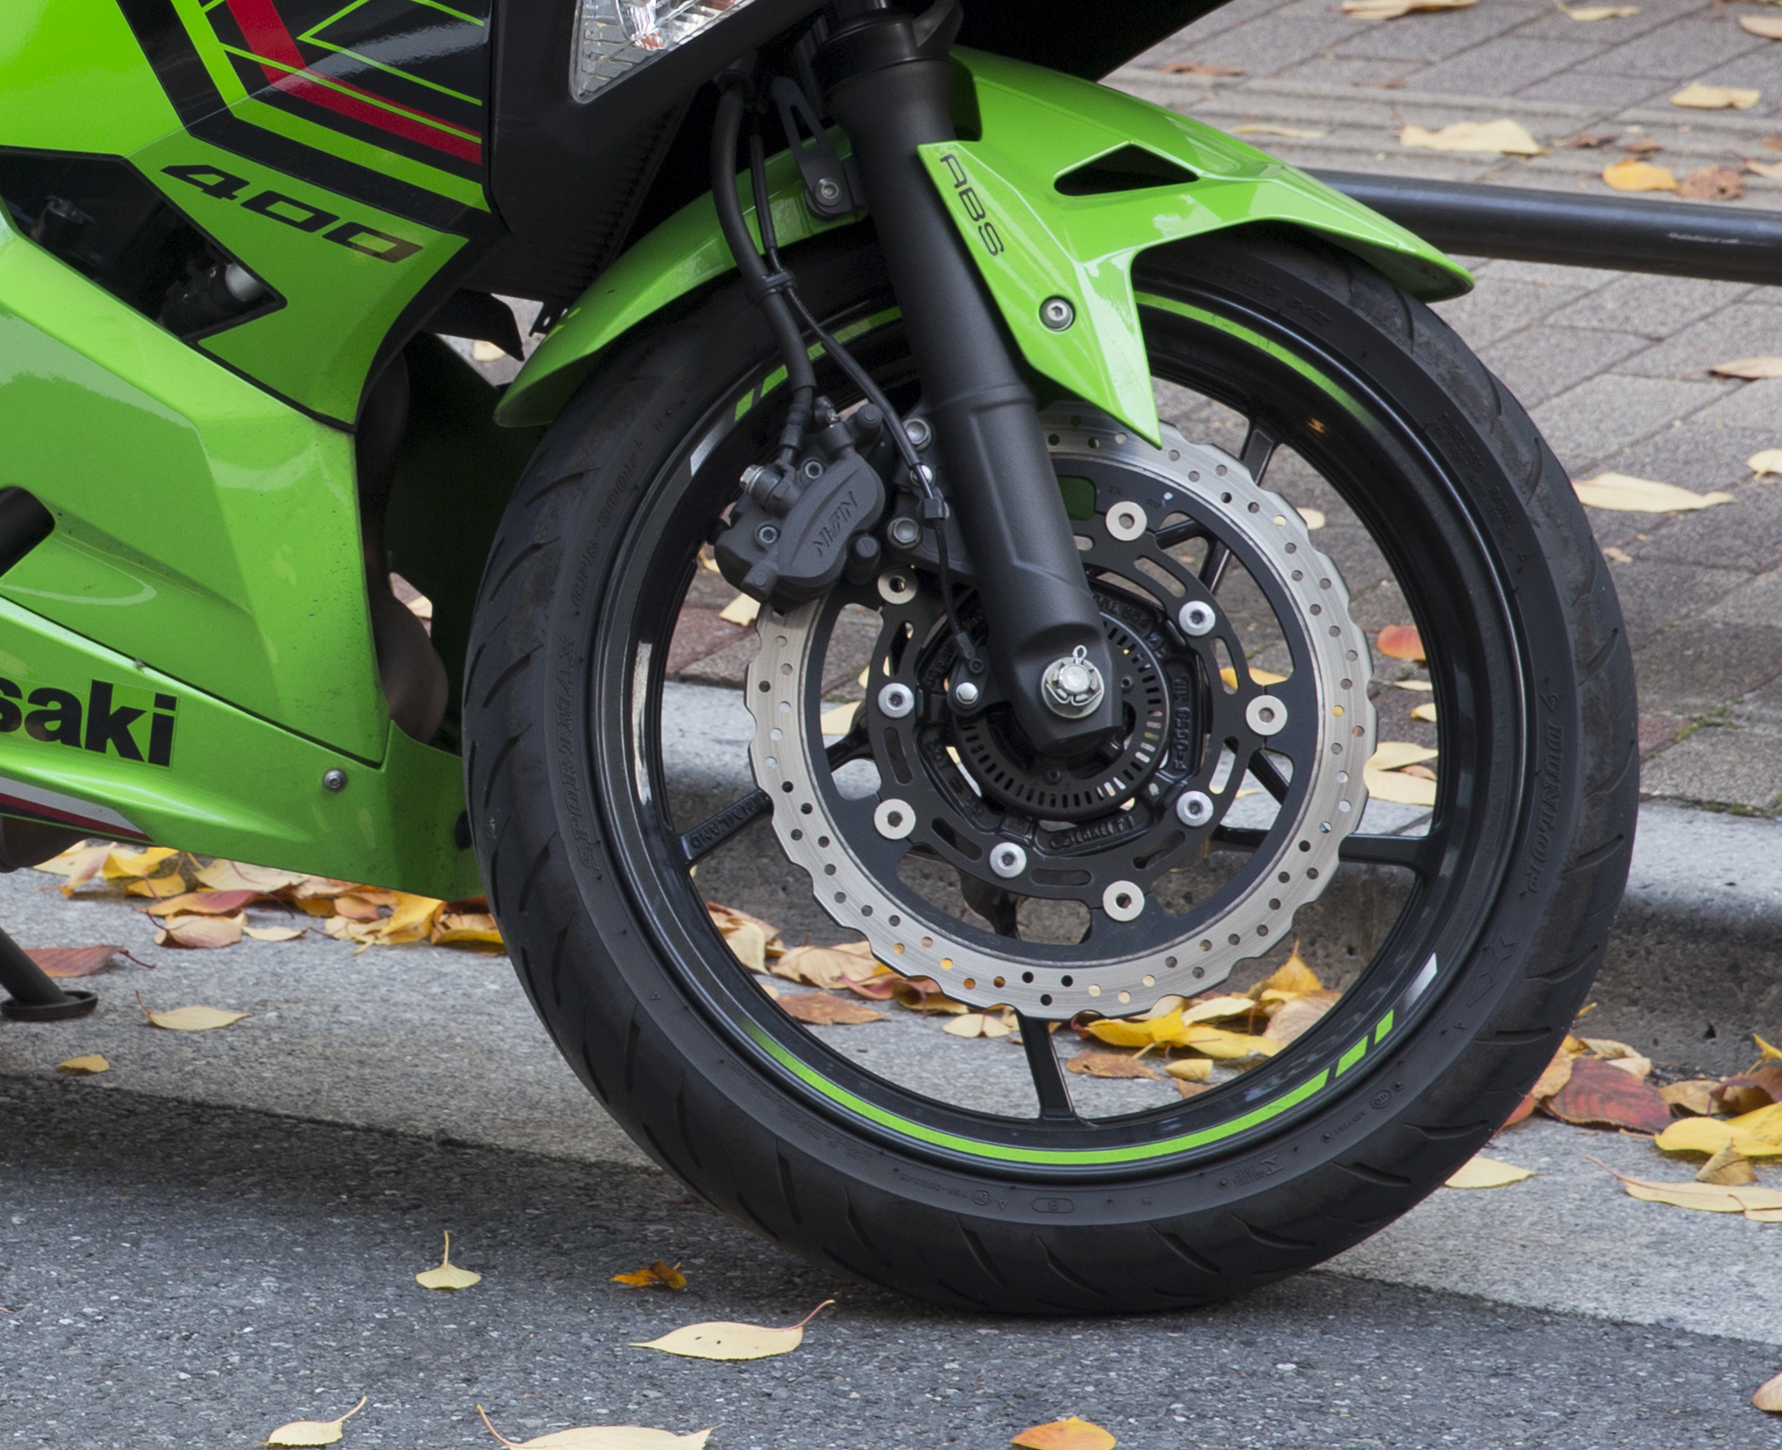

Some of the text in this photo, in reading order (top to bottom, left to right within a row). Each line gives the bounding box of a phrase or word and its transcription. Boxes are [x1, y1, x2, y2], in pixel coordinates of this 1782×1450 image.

[160, 164, 424, 264] 400
[940, 153, 1005, 257] ABS
[555, 634, 601, 872] SPORTMAX
[1527, 721, 1563, 894] DUNLOP
